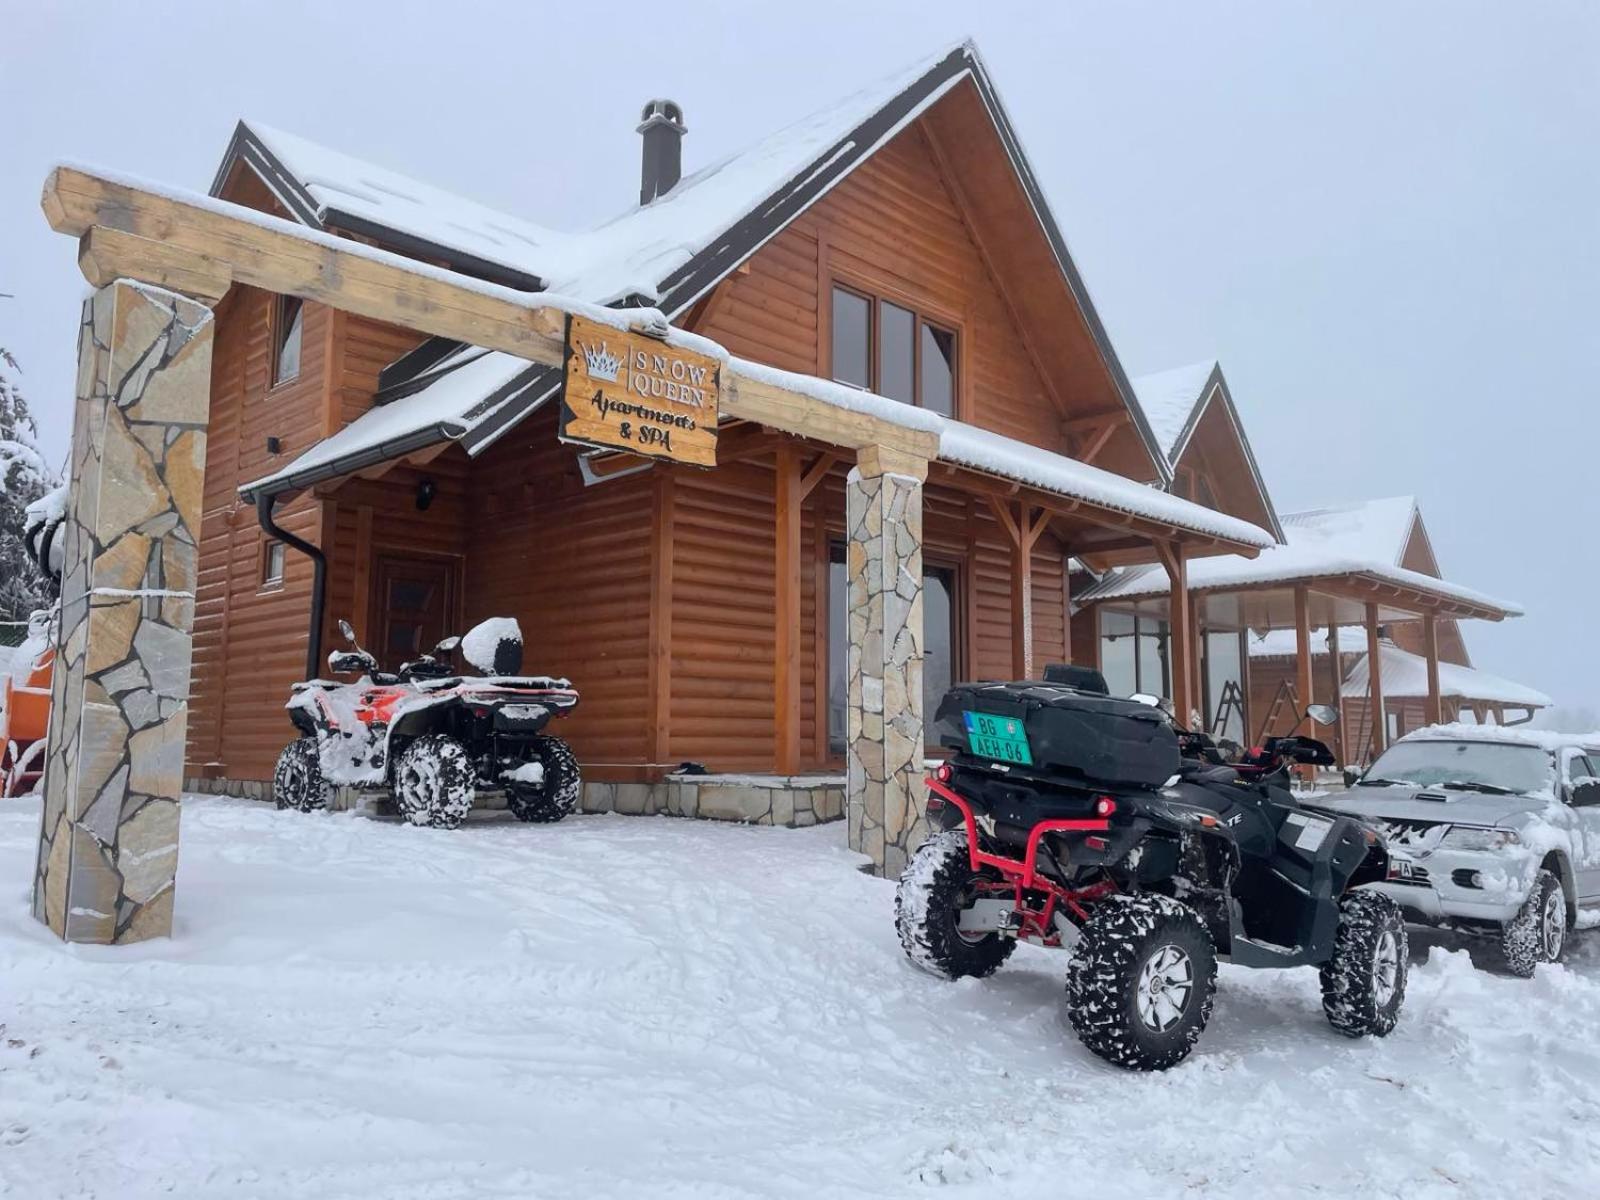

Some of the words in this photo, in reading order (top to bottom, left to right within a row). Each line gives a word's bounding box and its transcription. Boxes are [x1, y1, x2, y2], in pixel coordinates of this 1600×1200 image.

[636, 351, 707, 386] SNOW
[634, 373, 705, 408] QUEEN
[592, 389, 696, 431] Apartments
[620, 421, 632, 439] &
[638, 425, 672, 452] SPA
[979, 717, 997, 735] BG
